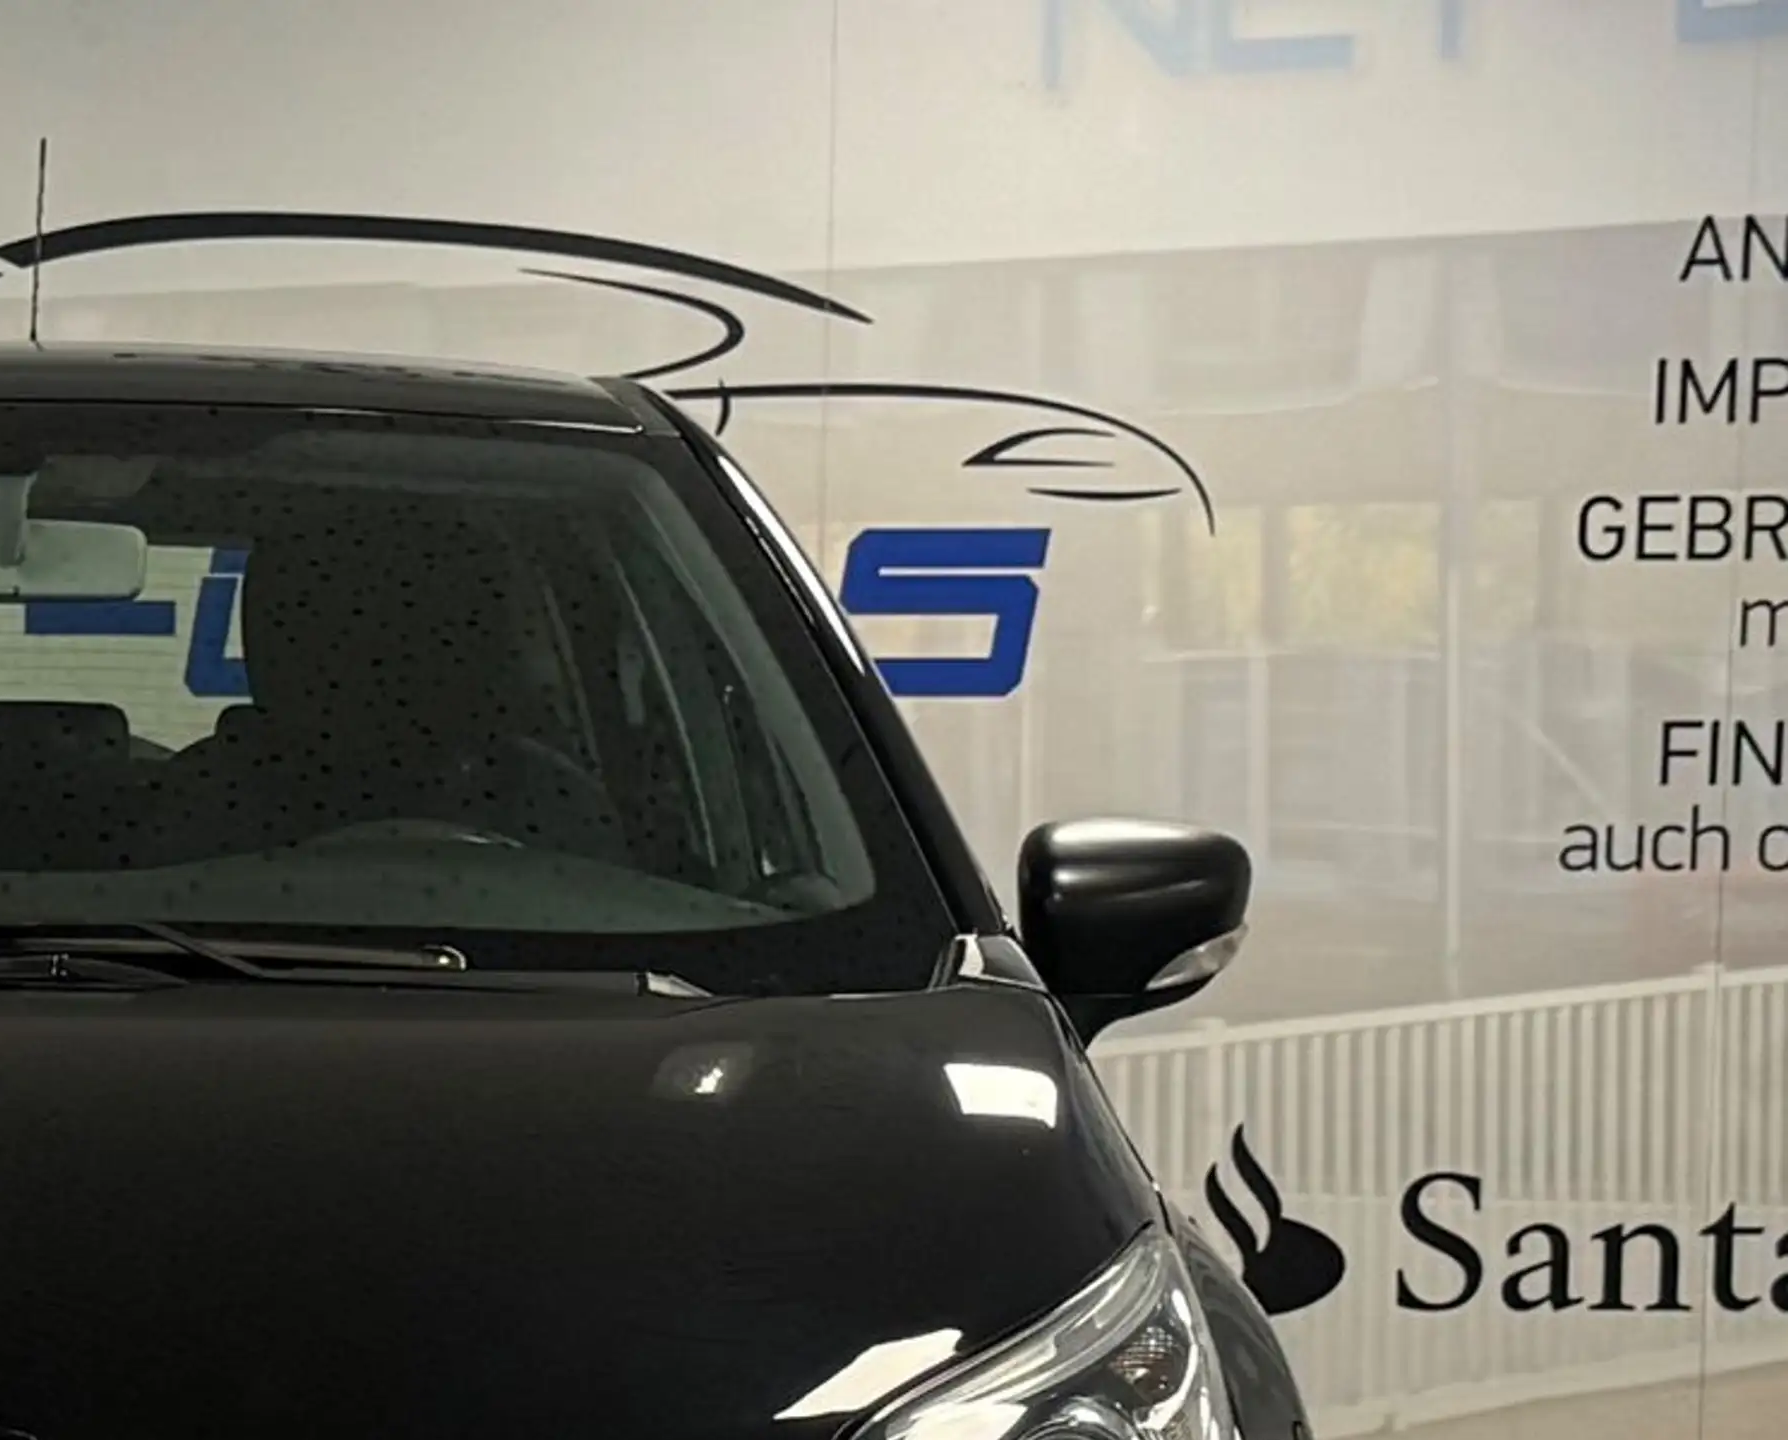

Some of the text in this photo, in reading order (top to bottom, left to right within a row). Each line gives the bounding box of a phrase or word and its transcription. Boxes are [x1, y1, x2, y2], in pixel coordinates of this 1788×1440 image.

[1679, 214, 1788, 282] AN
[1655, 357, 1788, 424] IMP
[1578, 494, 1788, 561] GEBR
[1659, 719, 1785, 787] FIN
[1558, 804, 1731, 872] auch
[1396, 1171, 1788, 1313] Sant
